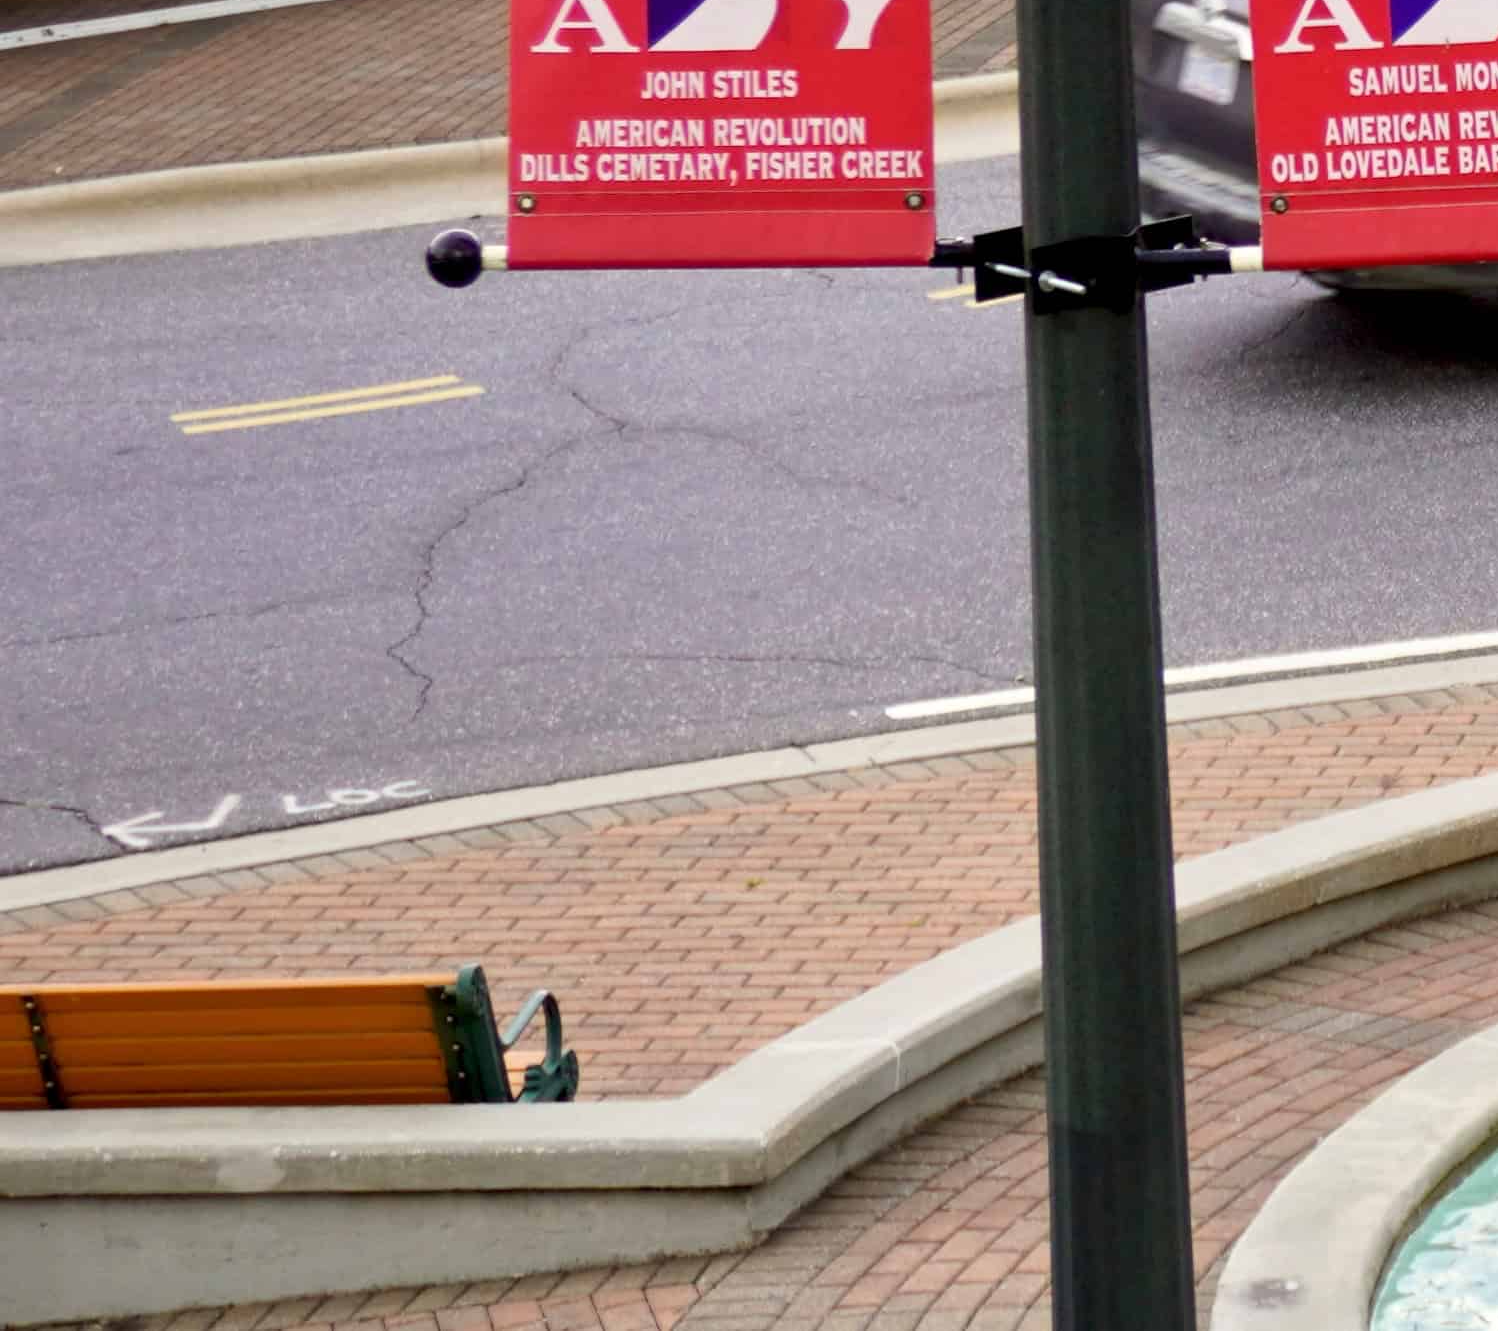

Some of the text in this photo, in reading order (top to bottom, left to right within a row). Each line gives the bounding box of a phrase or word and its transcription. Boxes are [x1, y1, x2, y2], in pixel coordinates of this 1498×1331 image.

[640, 69, 799, 99] JOHN STILES
[1348, 65, 1449, 97] SAMUEL
[575, 117, 866, 148] AMERICAN REVOLUTION
[1324, 113, 1450, 146] AMERICAN
[520, 150, 923, 183] DILLS CEMETARY, FISHER CREEK
[1271, 152, 1319, 183] OLD
[1326, 146, 1450, 180] LOVEDALE
